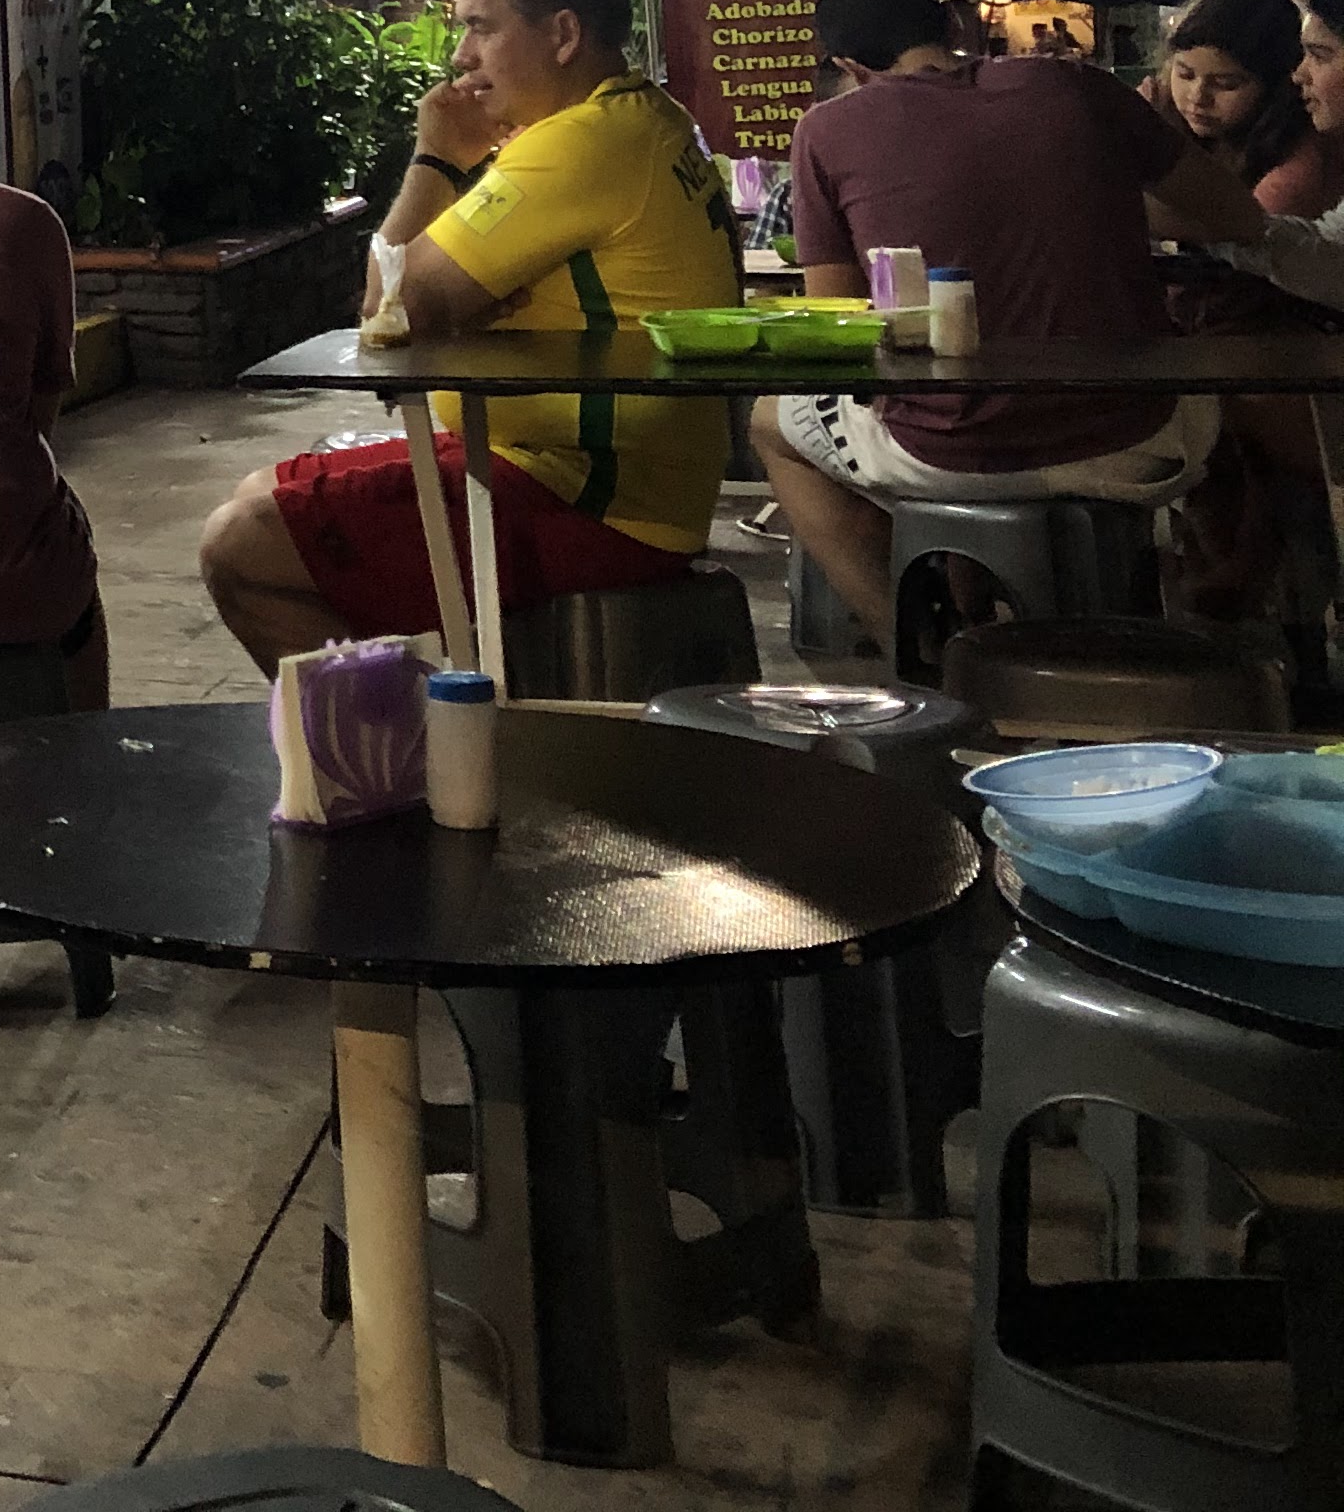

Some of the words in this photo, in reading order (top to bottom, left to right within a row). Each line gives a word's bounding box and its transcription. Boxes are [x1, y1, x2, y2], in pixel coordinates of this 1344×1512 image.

[712, 25, 814, 46] Chorizo
[712, 53, 817, 72] Carnaza
[720, 79, 814, 100] Lengua
[733, 102, 805, 123] Labio
[734, 129, 792, 151] Trip
